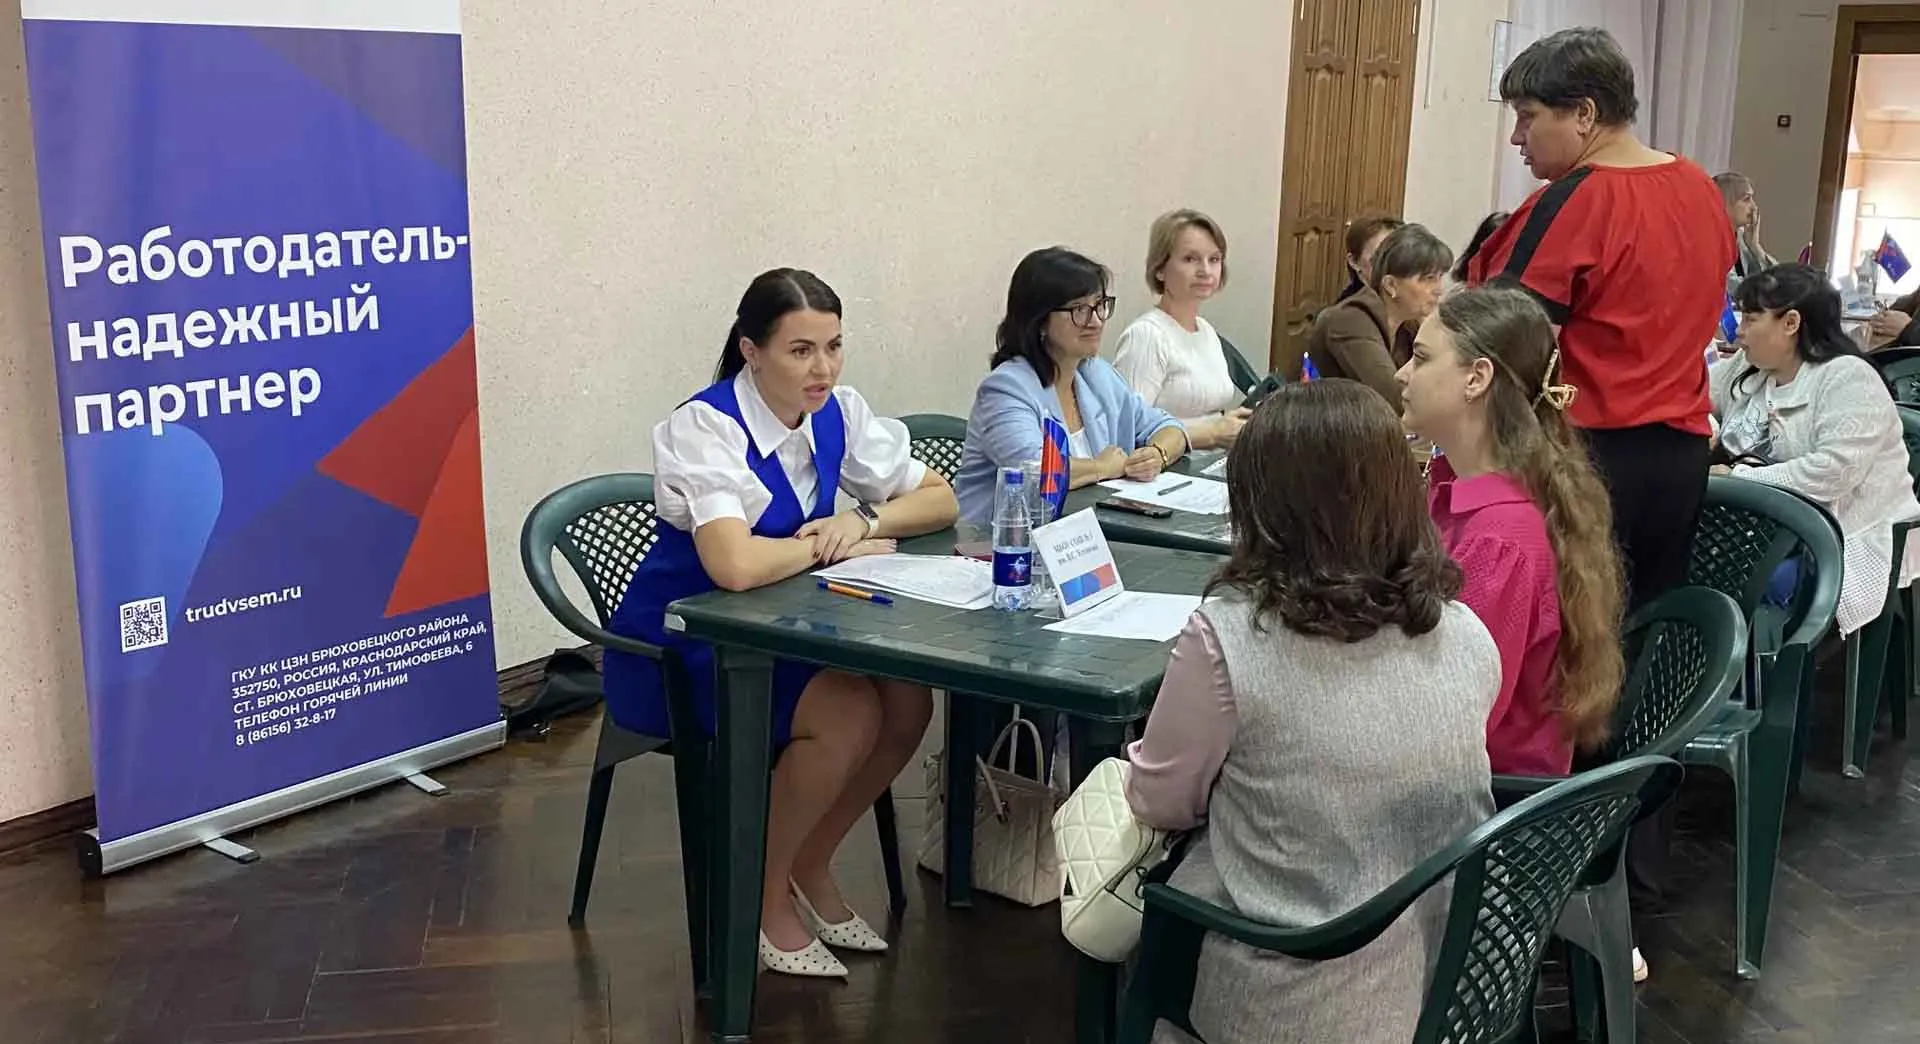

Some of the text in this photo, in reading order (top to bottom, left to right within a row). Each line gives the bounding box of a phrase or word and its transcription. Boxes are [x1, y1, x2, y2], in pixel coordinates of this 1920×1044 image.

[59, 225, 469, 288] Работодатель-
[67, 282, 380, 361] надежный
[74, 366, 322, 436] партнер
[185, 585, 302, 622] trudvsem.ru
[231, 613, 469, 683] ГКУ КК ЦЗН БРЮХОВЕЦКОГО РАЙОНА
[232, 621, 487, 699] 352750, РОССИЯ, КРАСНОДАРСКИЙ КРАЙ,
[233, 640, 473, 714] СТ. БРЮХОВЕЦКАЯ, УЛ. ТИМОФЕЕВА, 6
[234, 673, 408, 730] ТЕЛЕФОН ГОРЯЧЕЙ ЛИНИИ
[235, 708, 336, 746] 8 (86156) 32-8-17
